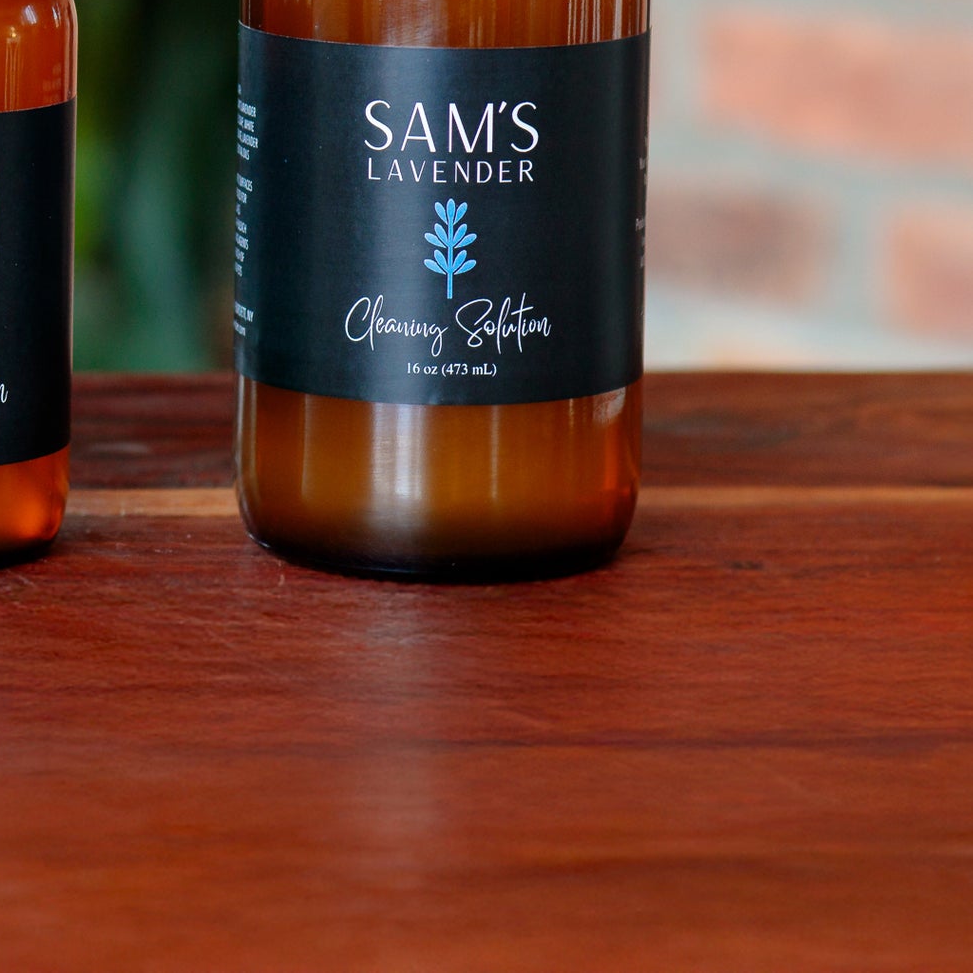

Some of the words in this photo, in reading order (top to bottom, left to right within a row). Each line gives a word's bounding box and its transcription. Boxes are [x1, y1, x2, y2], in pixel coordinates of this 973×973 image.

[364, 99, 539, 154] SAM'S
[367, 157, 534, 184] LAVENDER
[343, 293, 450, 359] Cleaning
[455, 292, 552, 354] Solution
[406, 362, 421, 375] 16
[423, 365, 439, 375] oz
[441, 363, 469, 378] (473
[472, 363, 497, 377] mL)
